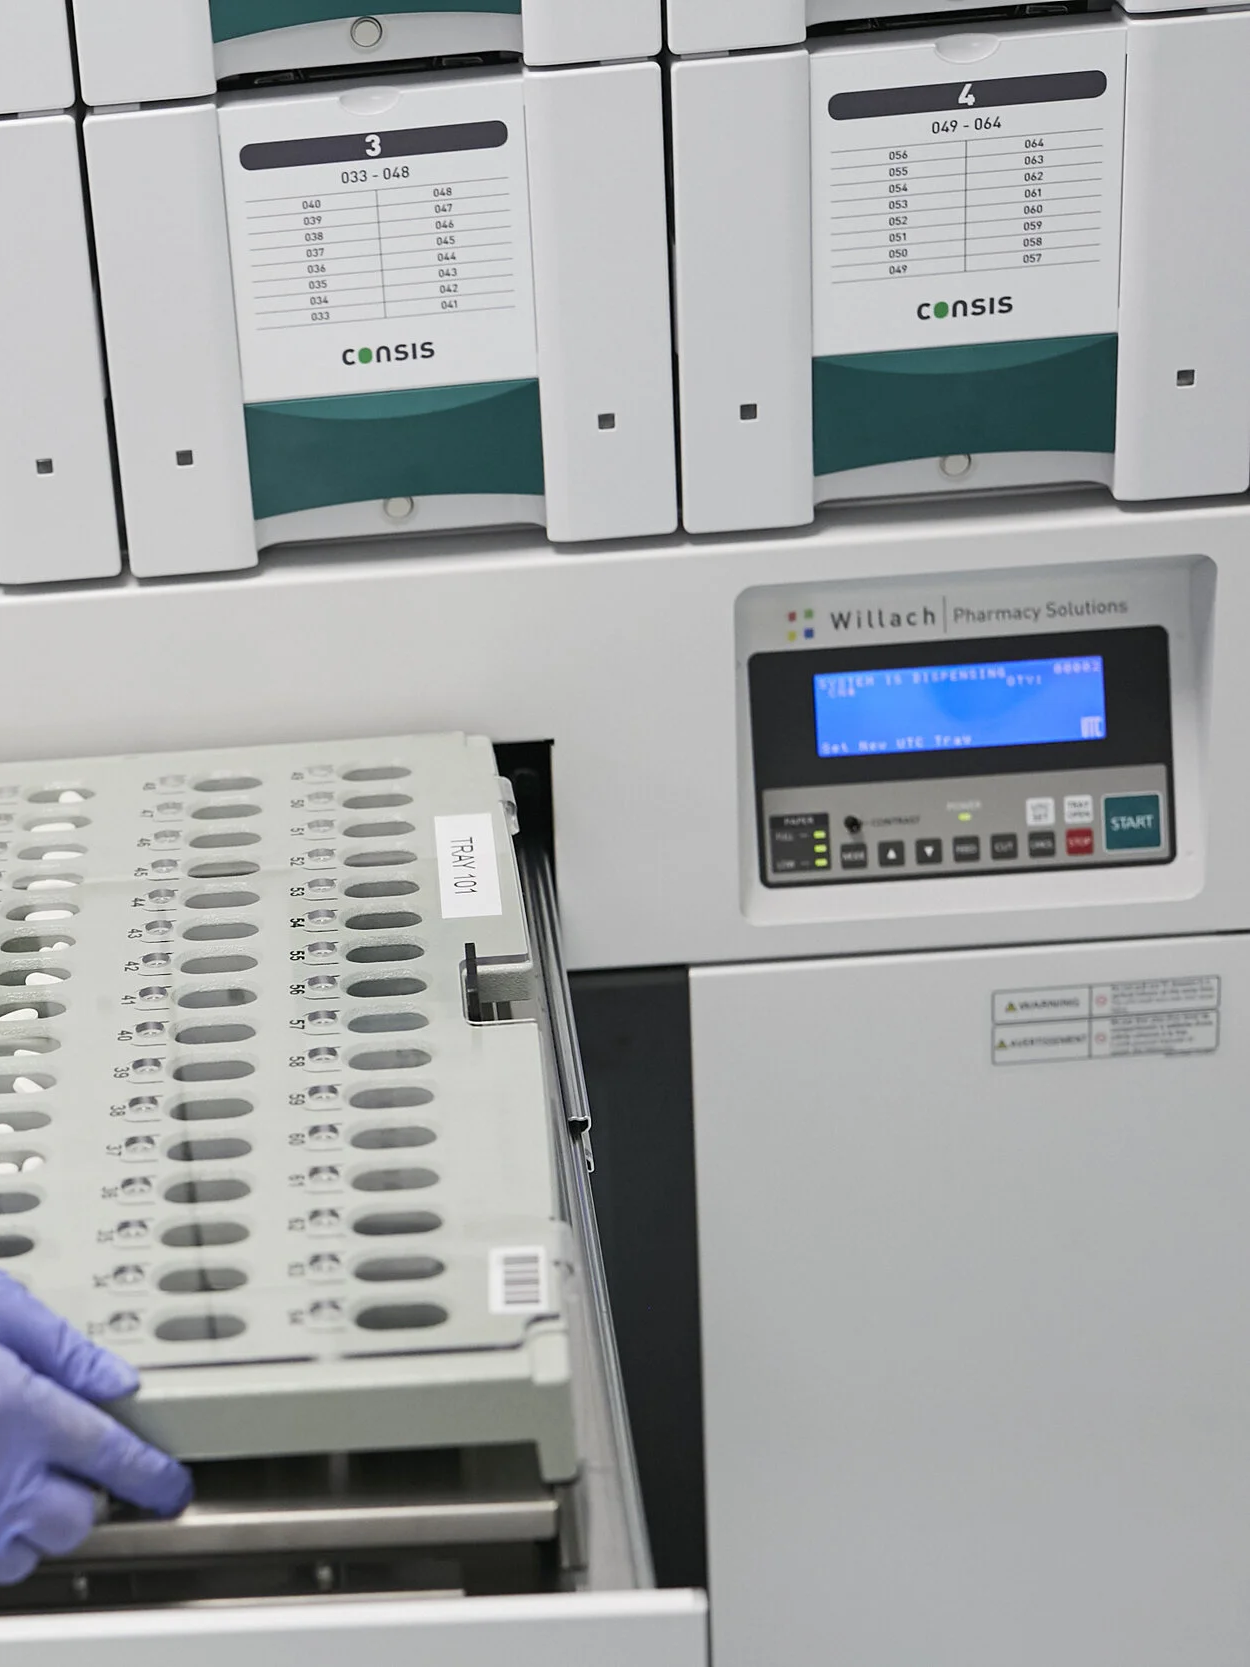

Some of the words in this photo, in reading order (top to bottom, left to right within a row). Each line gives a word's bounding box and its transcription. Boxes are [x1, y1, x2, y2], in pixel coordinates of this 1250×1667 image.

[958, 83, 975, 106] 4
[932, 120, 957, 133] 049
[974, 116, 1001, 130] 064
[365, 134, 381, 156] 3
[1025, 139, 1044, 148] 064
[889, 151, 908, 160] 056
[1025, 156, 1043, 165] 063
[341, 170, 367, 183] 033
[383, 166, 409, 180] 048
[889, 167, 908, 177] 055
[1025, 172, 1043, 181] 062
[433, 187, 452, 197] 048
[889, 184, 908, 193] 054
[1025, 189, 1041, 198] 061
[302, 200, 321, 209] 040
[435, 204, 452, 213] 047
[889, 200, 908, 210] 053
[1024, 205, 1042, 214] 060
[304, 216, 322, 225] 039
[435, 220, 454, 229] 046
[889, 217, 908, 226] 052
[1024, 221, 1042, 231] 059
[305, 232, 323, 241] 038
[437, 236, 455, 245] 045
[889, 233, 906, 242] 051
[1023, 238, 1042, 247] 058
[307, 248, 324, 258] 037
[438, 253, 456, 262] 044
[889, 249, 908, 258] 050
[1023, 254, 1041, 263] 057
[308, 264, 326, 273] 036
[439, 268, 457, 278] 043
[889, 265, 907, 275] 049
[309, 280, 327, 289] 035
[440, 284, 458, 294] 042
[310, 296, 328, 305] 034
[441, 300, 457, 309] 041
[311, 312, 329, 321] 033
[954, 604, 1040, 626] Pharmacy
[1046, 600, 1128, 618] Solutions
[831, 607, 936, 631] Willach
[1110, 815, 1153, 831] START
[291, 828, 304, 836] 51
[137, 838, 150, 847] 46
[451, 837, 476, 869] TRAY
[291, 857, 304, 866] 52
[134, 867, 148, 877] 45
[454, 874, 477, 894] 101
[290, 888, 304, 896] 53
[131, 898, 145, 907] 44
[290, 918, 304, 928] 54
[128, 929, 142, 939] 43
[290, 951, 305, 961] 55
[124, 962, 139, 972] 42
[290, 985, 305, 995] 56
[121, 995, 136, 1005] 41
[289, 1020, 305, 1029] 57
[117, 1030, 132, 1041] 40
[289, 1056, 305, 1067] 58
[114, 1067, 129, 1078] 39
[289, 1094, 305, 1105] 59
[110, 1105, 126, 1117] 38
